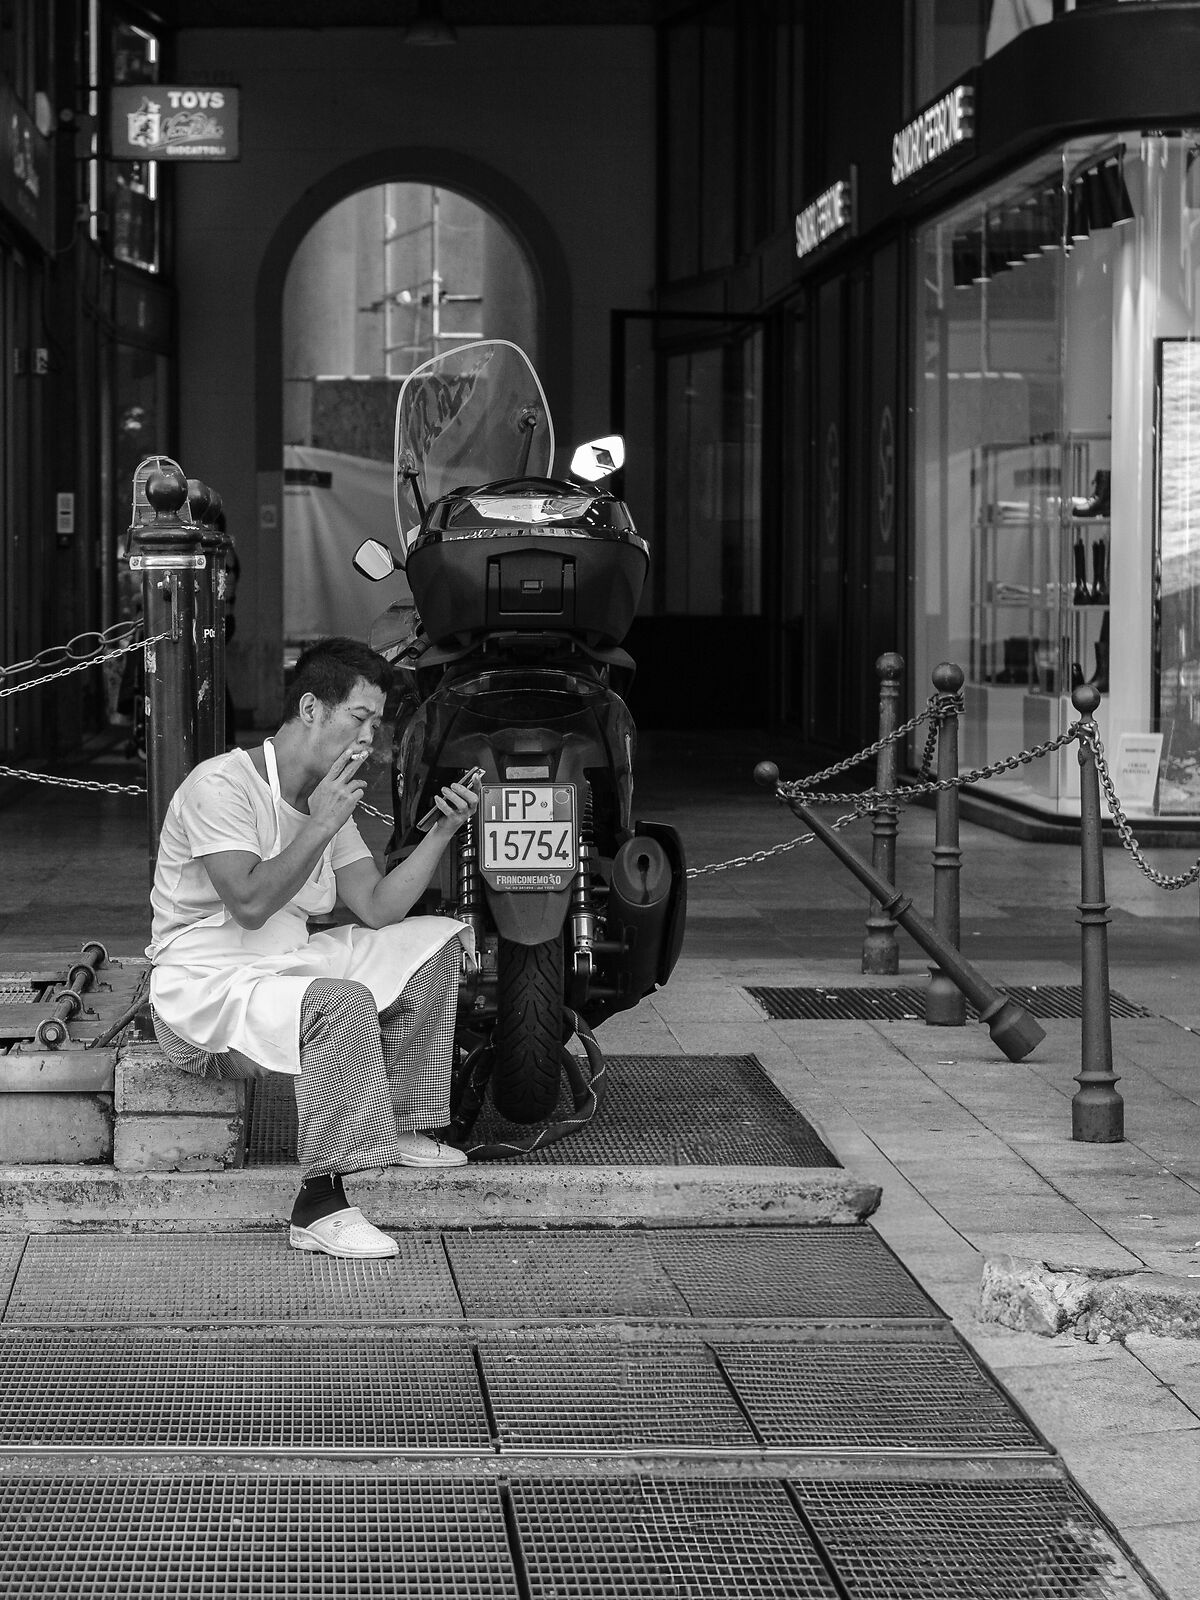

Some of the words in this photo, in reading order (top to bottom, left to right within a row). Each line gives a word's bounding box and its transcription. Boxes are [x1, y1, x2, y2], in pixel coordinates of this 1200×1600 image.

[167, 91, 225, 109] TOYS
[504, 790, 537, 820] FP
[489, 829, 570, 861] 15754
